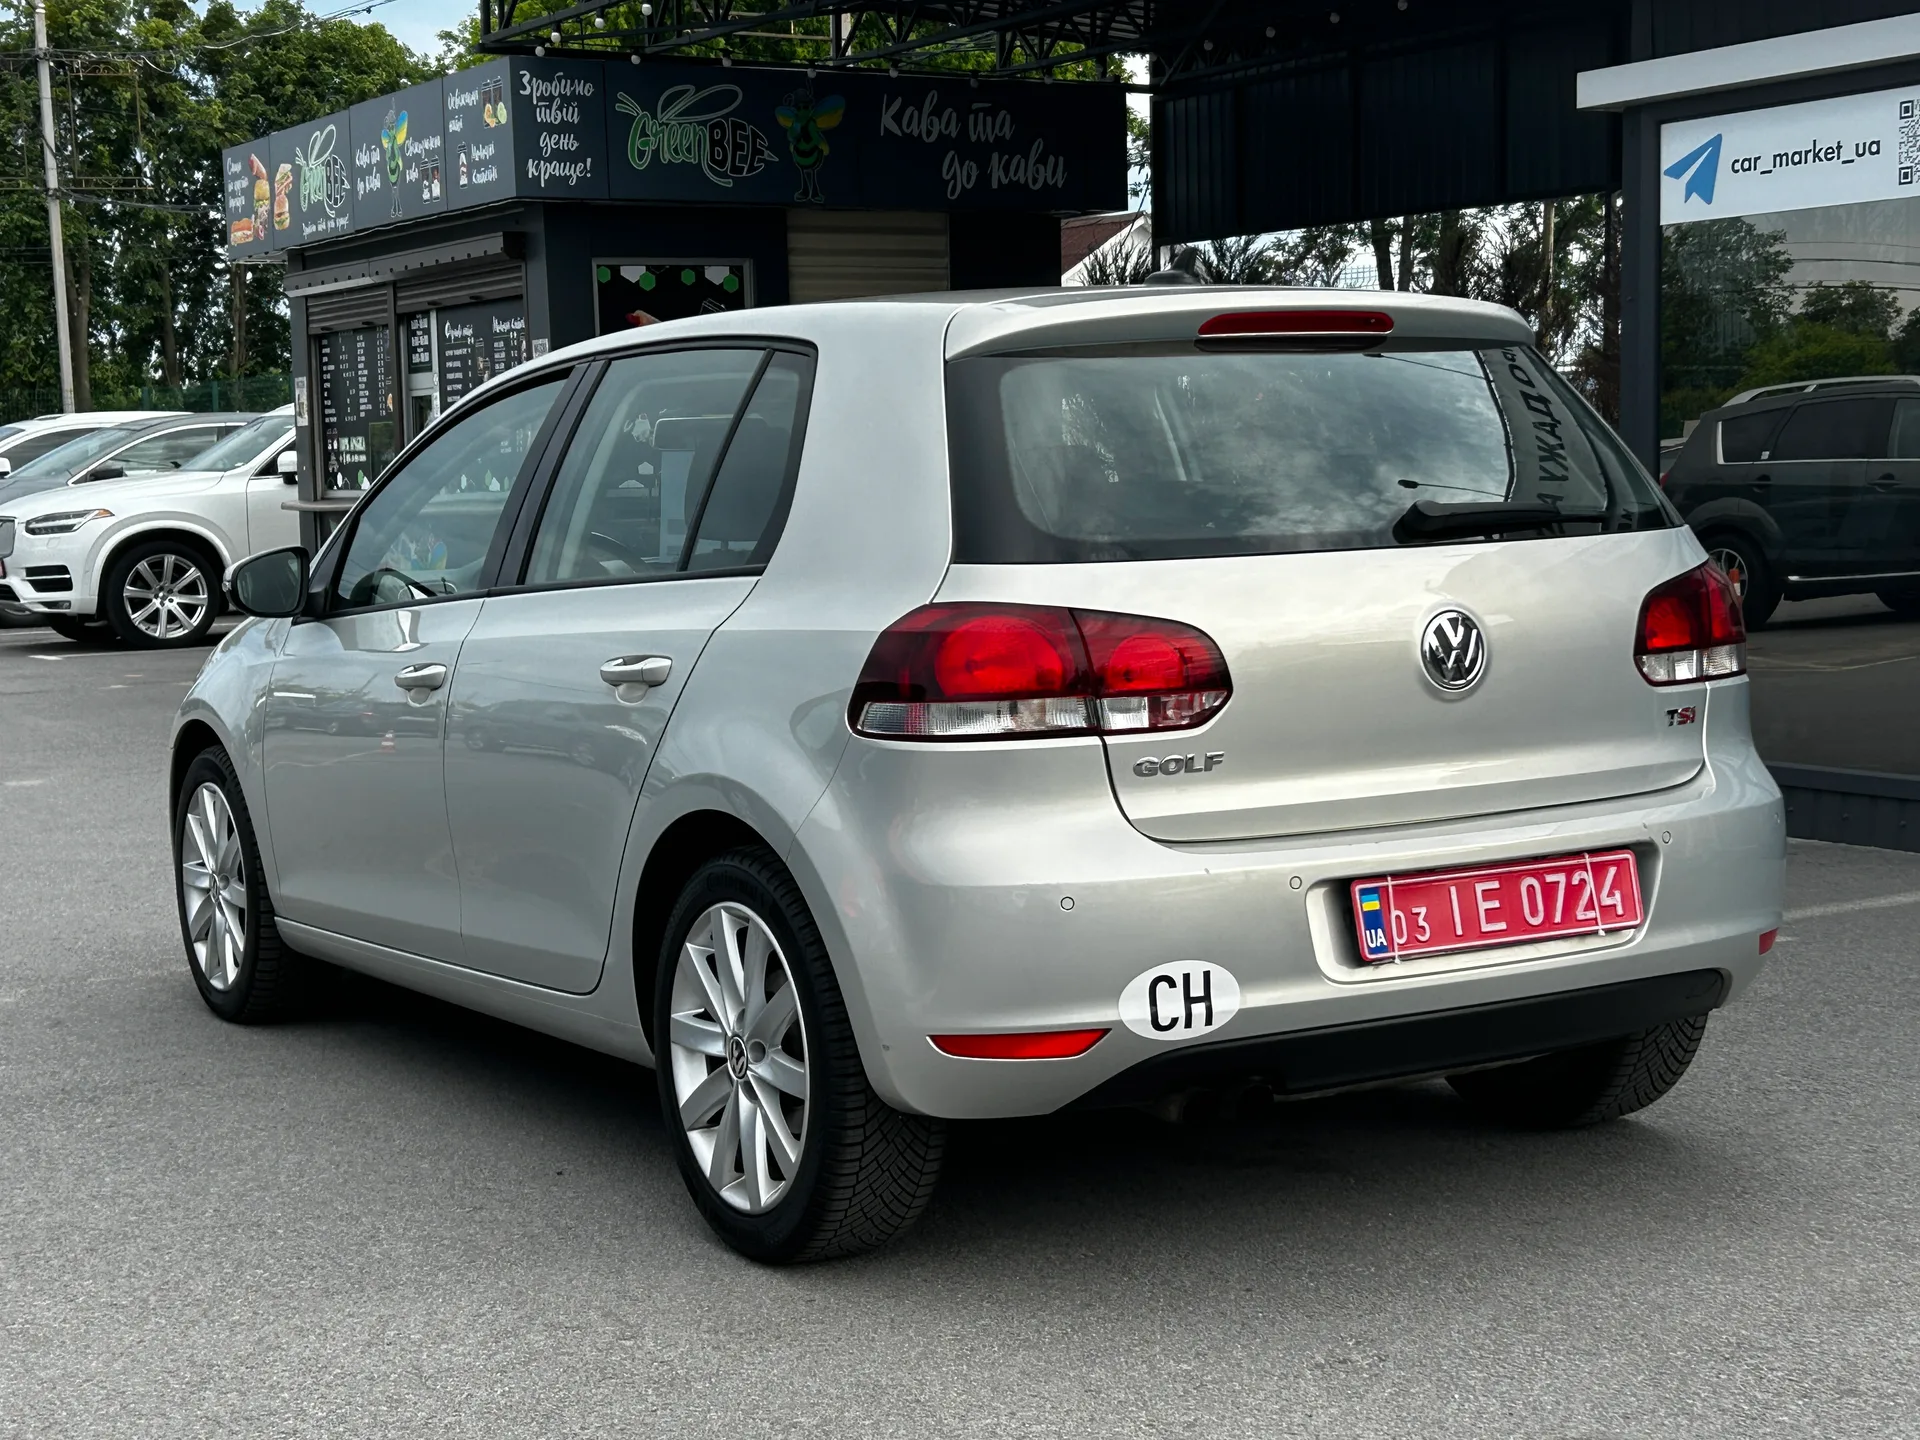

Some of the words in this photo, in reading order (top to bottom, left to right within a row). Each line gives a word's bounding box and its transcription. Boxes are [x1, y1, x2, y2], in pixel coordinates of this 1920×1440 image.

[519, 70, 595, 105] Зробимо
[536, 97, 581, 125] твій
[880, 90, 961, 143] Кава
[968, 103, 1015, 143] та
[539, 131, 580, 157] день
[1731, 139, 1881, 175] car_market_ua
[526, 157, 592, 188] краще!
[942, 150, 980, 200] до
[987, 138, 1068, 190] кави
[1665, 705, 1696, 727] TSI
[1132, 751, 1225, 778] GOLF
[1391, 906, 1431, 945] 03
[1450, 880, 1507, 936] IE
[1520, 866, 1625, 927] 0724
[1366, 929, 1388, 949] UA
[1148, 969, 1213, 1032] CH
